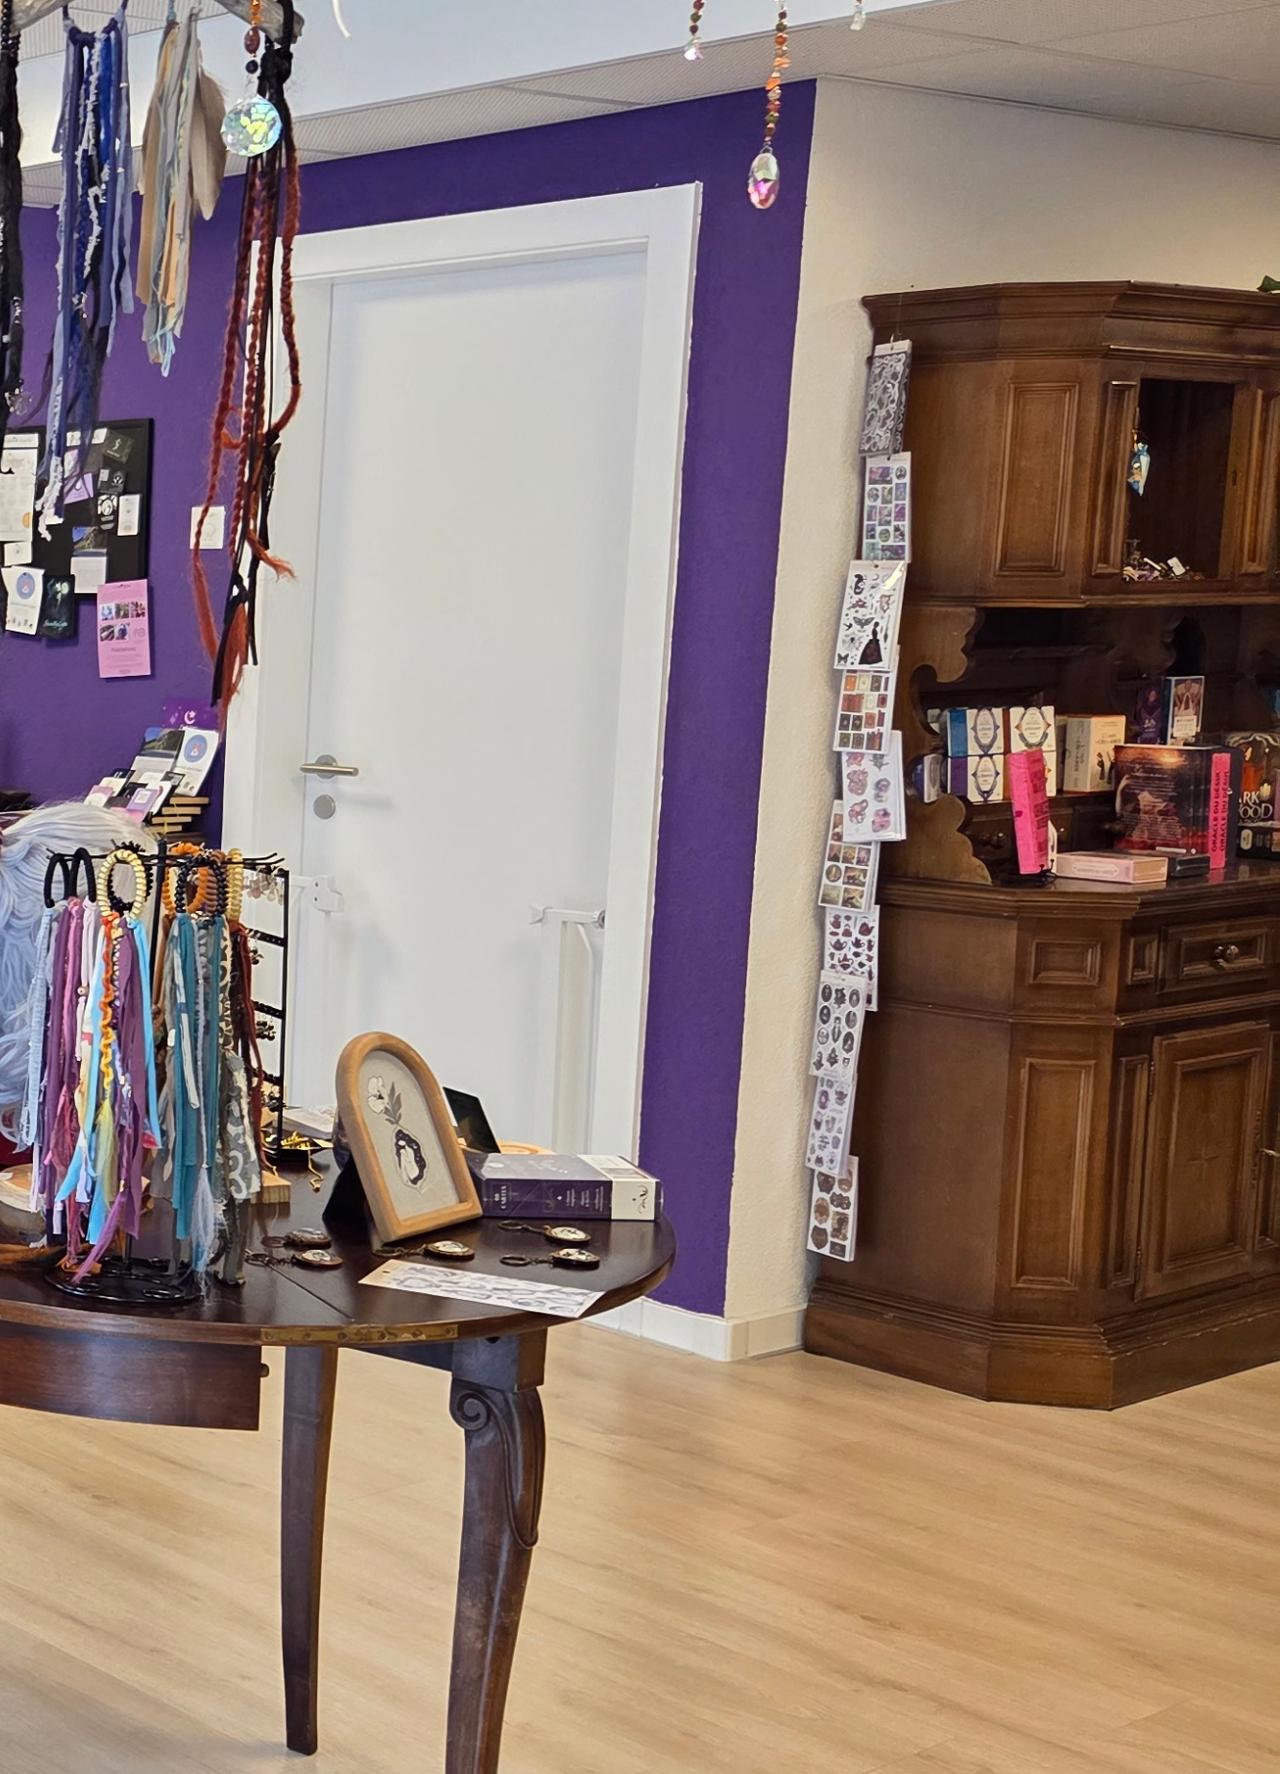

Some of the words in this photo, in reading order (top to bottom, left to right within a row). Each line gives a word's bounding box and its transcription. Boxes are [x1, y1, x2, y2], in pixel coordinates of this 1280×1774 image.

[1239, 791, 1260, 805] RK
[1213, 801, 1220, 814] DU
[1211, 816, 1219, 852] ORACLE
